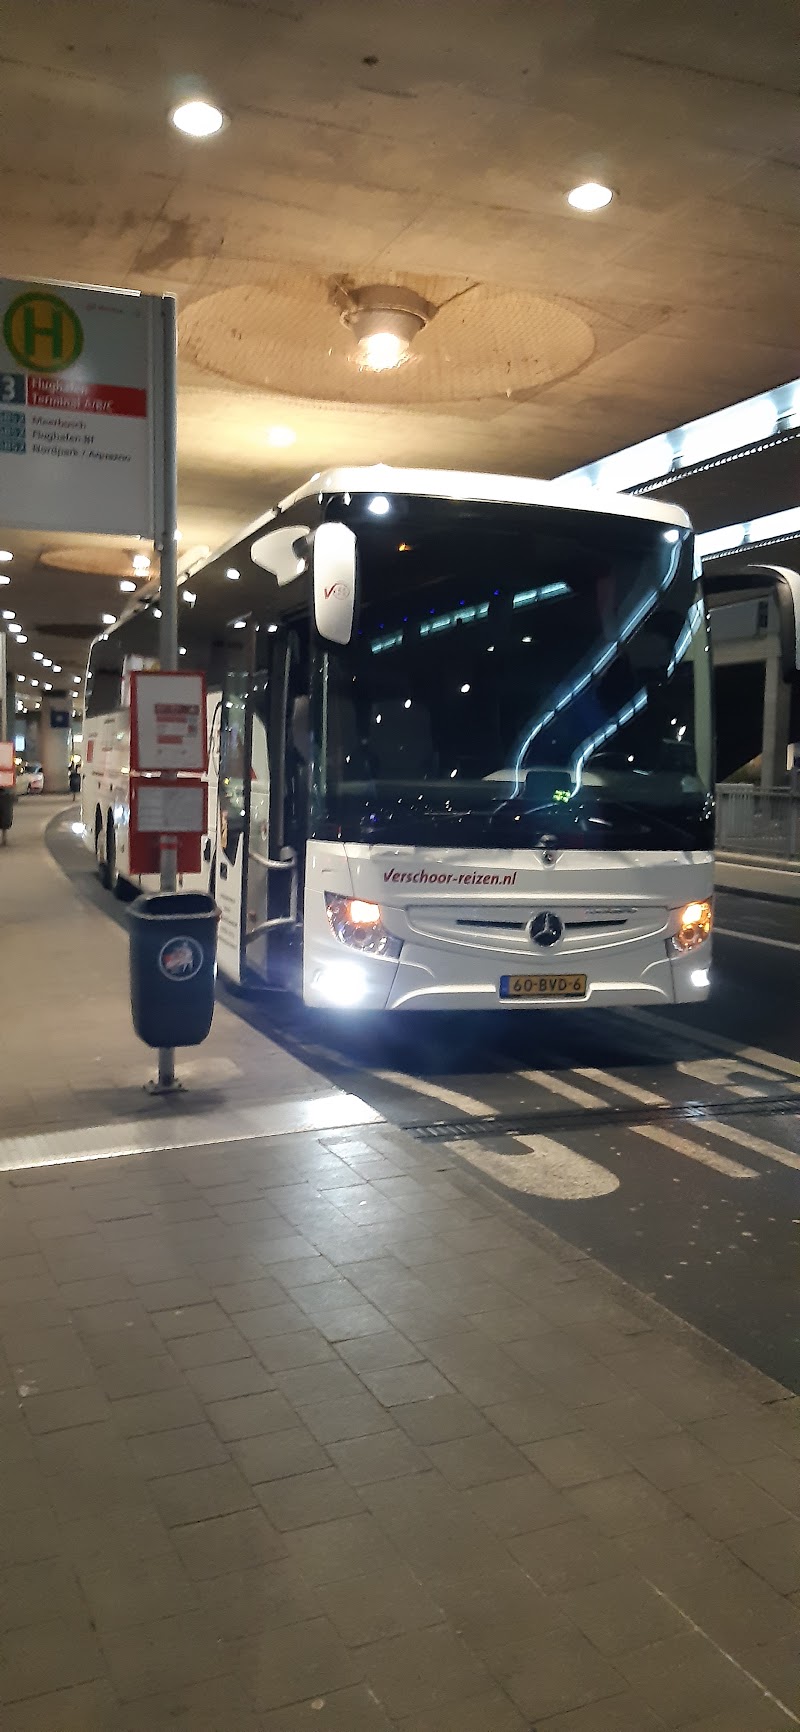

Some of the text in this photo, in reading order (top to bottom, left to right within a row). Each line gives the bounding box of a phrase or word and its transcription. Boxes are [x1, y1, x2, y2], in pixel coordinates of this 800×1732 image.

[23, 306, 64, 358] H
[32, 392, 81, 409] Terminal
[32, 429, 81, 443] Flughafen
[383, 867, 518, 886] Verschoor-reizen.nl
[512, 978, 582, 992] 60-BVD-6
